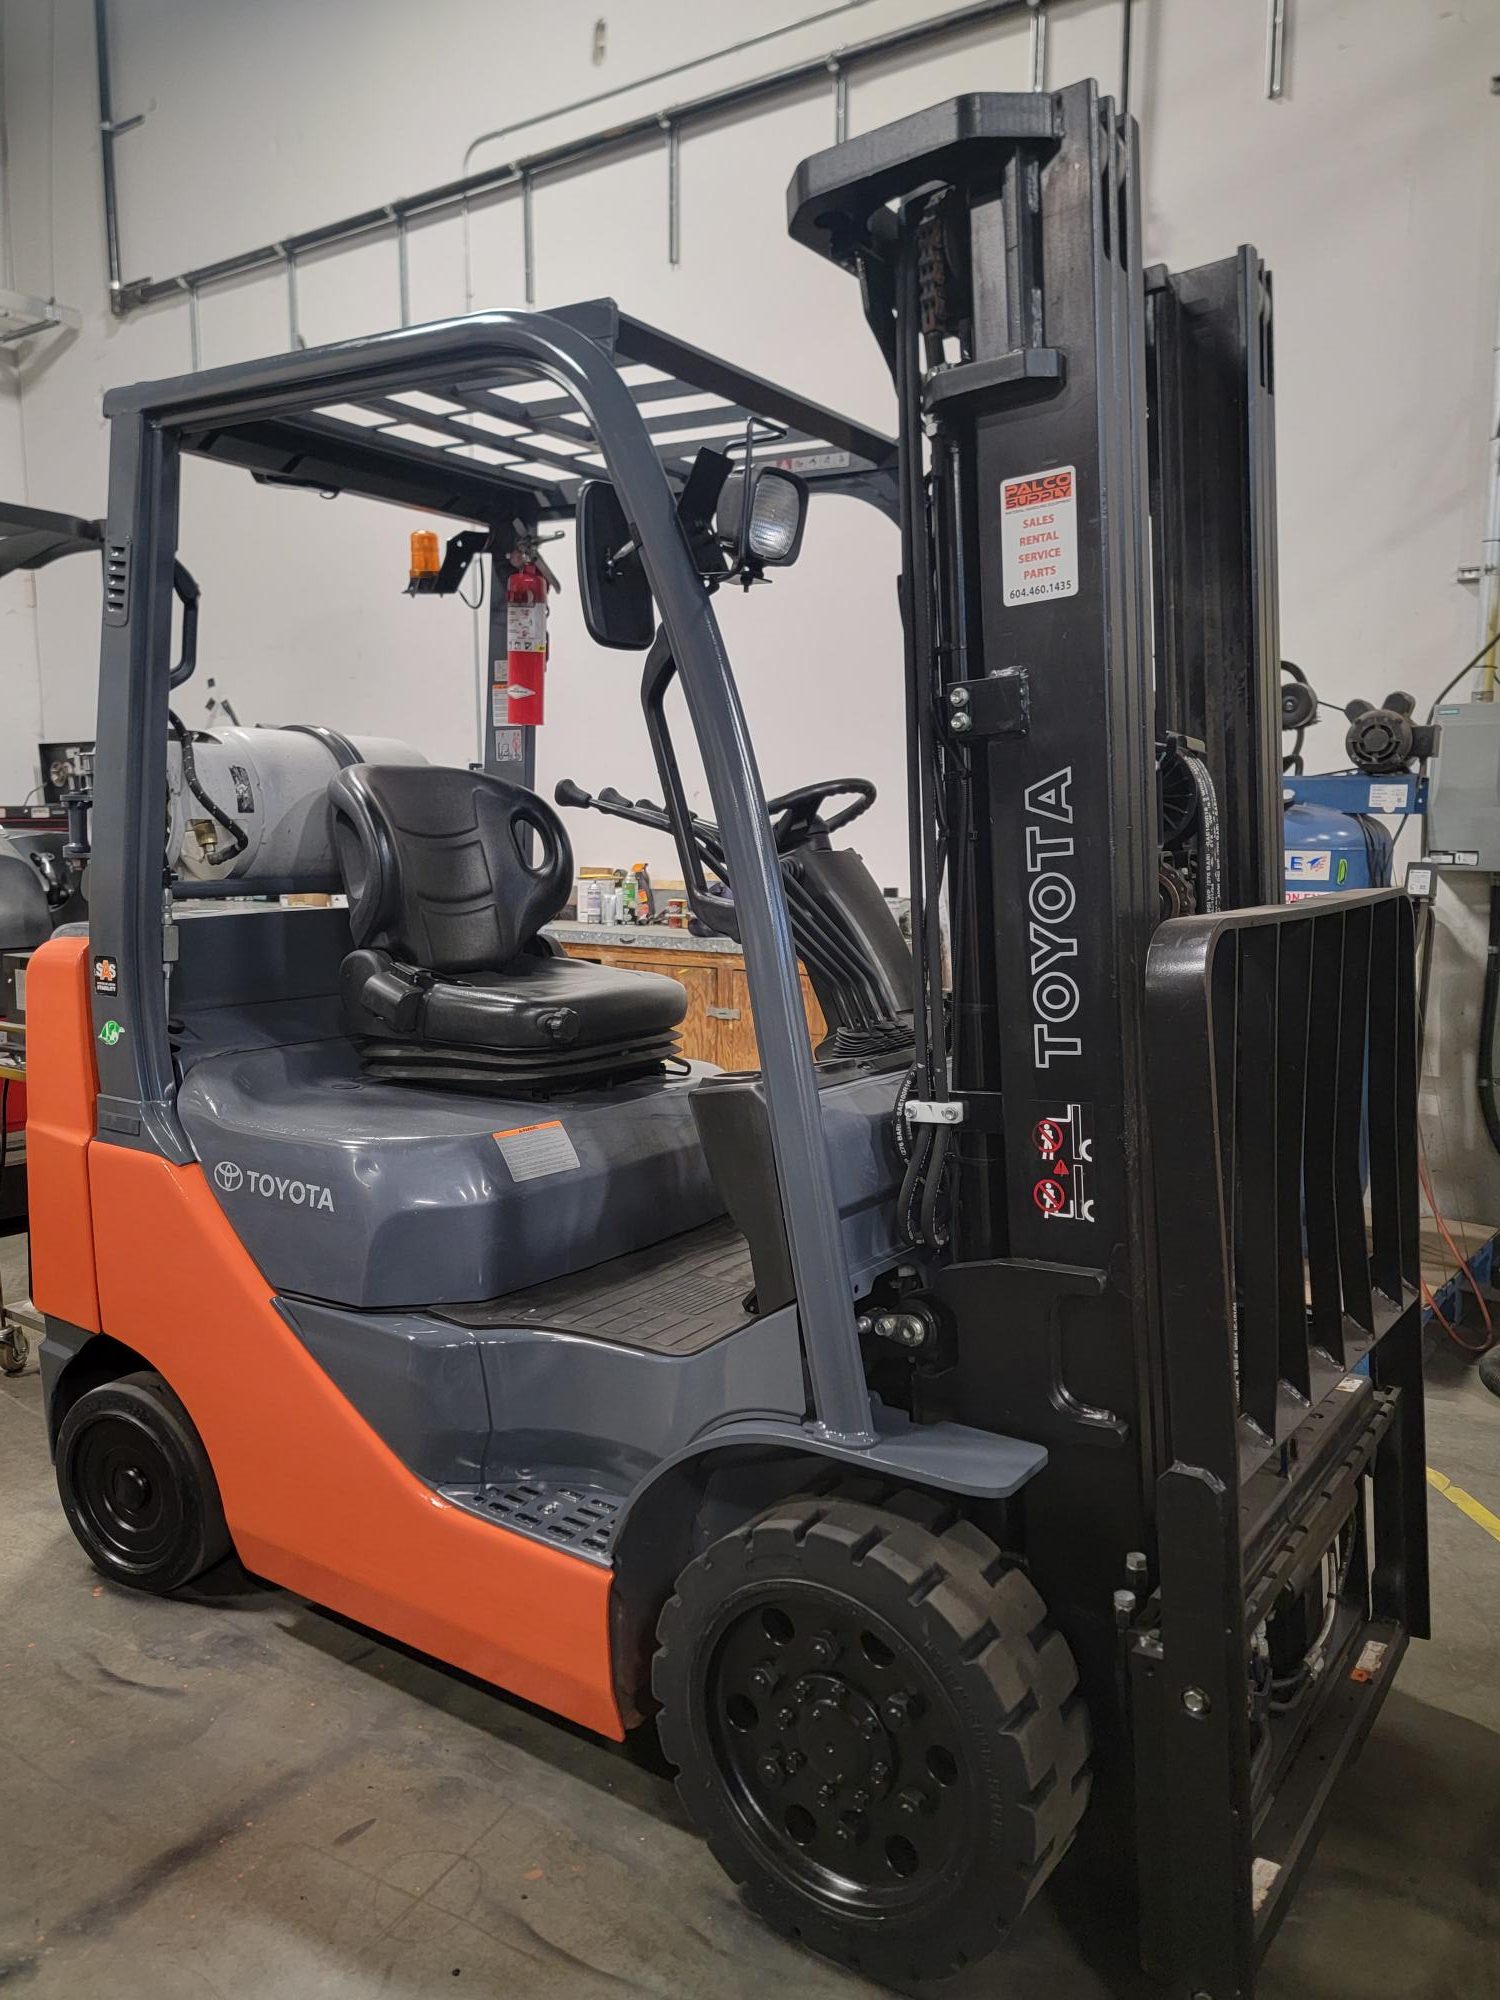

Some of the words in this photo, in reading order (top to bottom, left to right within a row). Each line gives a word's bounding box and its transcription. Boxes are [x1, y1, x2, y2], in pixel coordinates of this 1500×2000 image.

[1006, 473, 1071, 498] PALCO
[1006, 486, 1071, 509] SUPPLY
[1023, 514, 1054, 529] SALES
[1020, 531, 1059, 546] RENTAL
[1018, 548, 1061, 564] SERVICE
[1024, 565, 1056, 580] PARTS
[1010, 580, 1072, 599] 604.460.1435
[1024, 765, 1082, 1069] TOYOTA
[95, 960, 116, 981] SAS
[246, 1170, 334, 1212] TOYOTA
